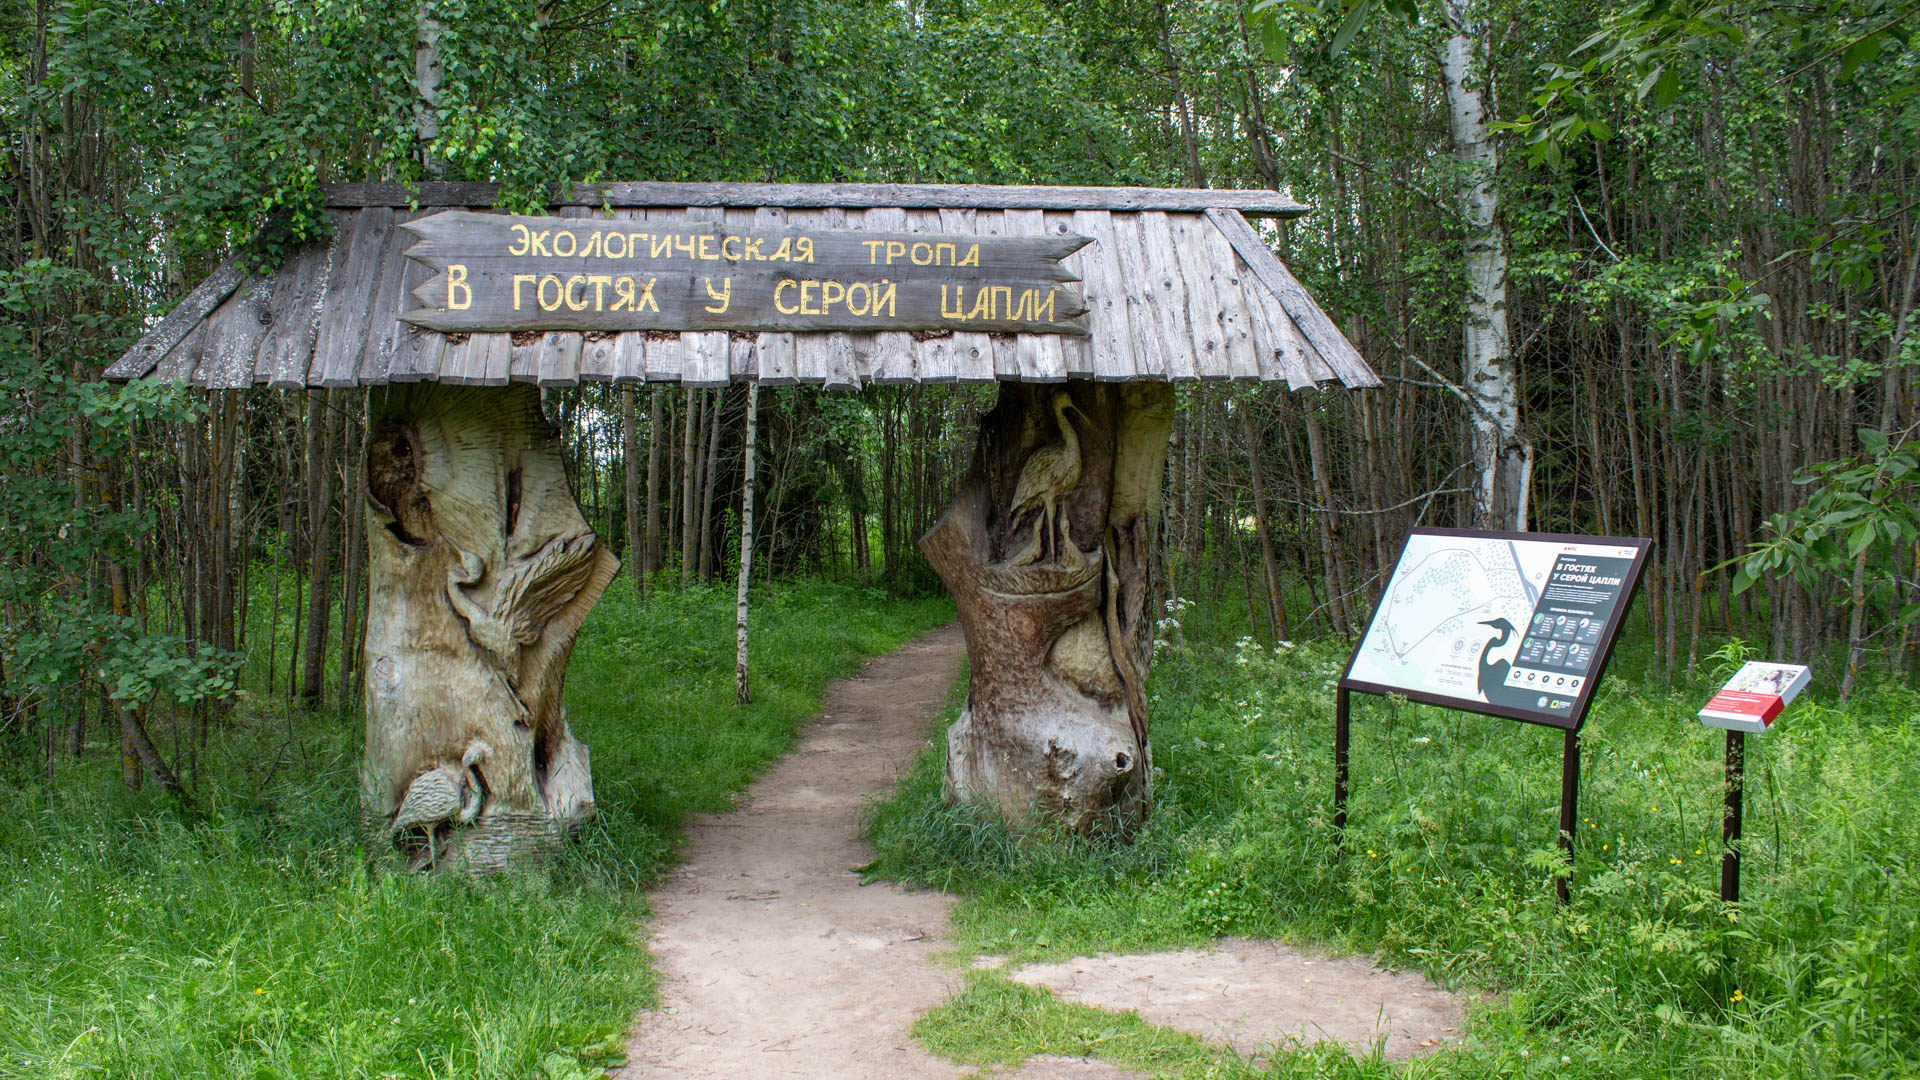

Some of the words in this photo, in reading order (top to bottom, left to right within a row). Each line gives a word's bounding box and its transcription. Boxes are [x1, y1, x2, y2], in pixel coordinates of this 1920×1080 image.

[508, 223, 815, 263] ЭКОЛОГИЧЕСКАЯ
[861, 240, 980, 267] ТРОПА
[513, 274, 660, 313] ГОСТЯХ
[705, 277, 731, 314] У
[773, 278, 896, 317] СЕРОЙ
[1556, 563, 1563, 571] В
[1564, 564, 1597, 573] ГОСТЯХ
[1560, 573, 1589, 583] СЕРОЙ
[1589, 576, 1621, 585] ЦАПЛИ
